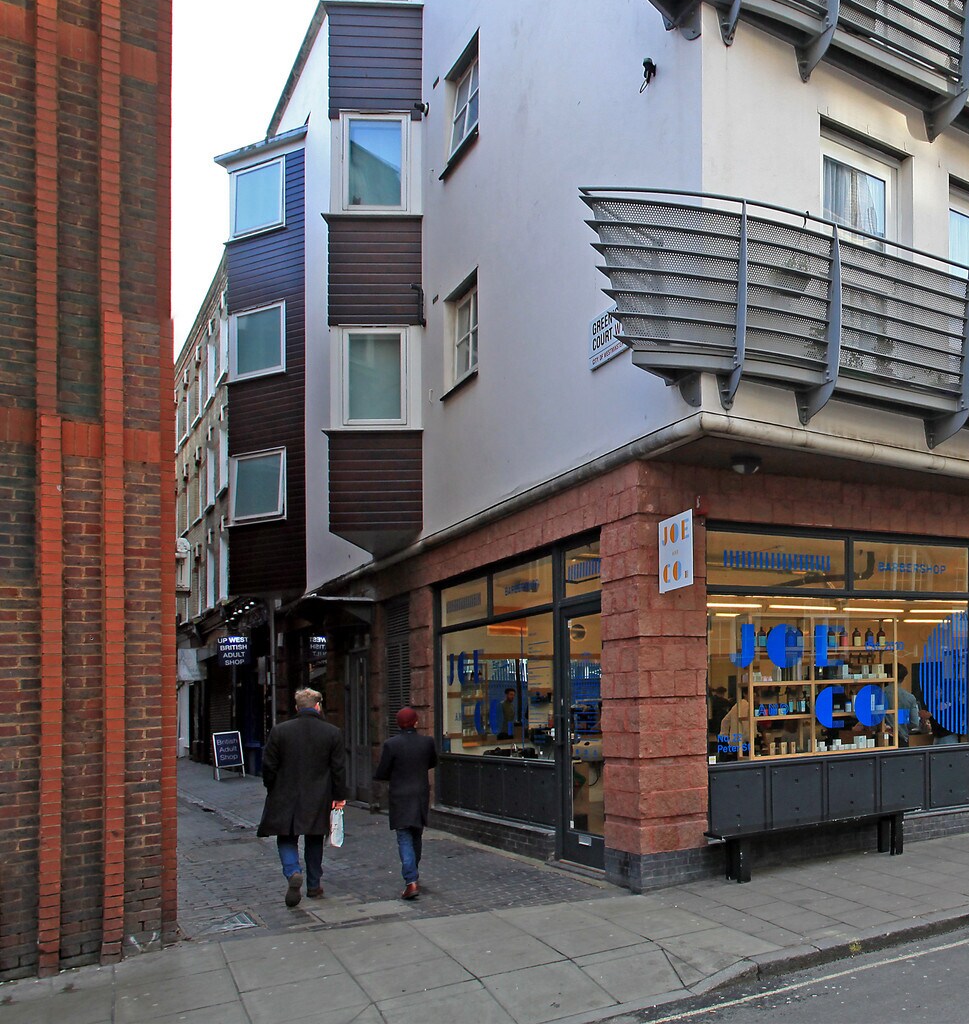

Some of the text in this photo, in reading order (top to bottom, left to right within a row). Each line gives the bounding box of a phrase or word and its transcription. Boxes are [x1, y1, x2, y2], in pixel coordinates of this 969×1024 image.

[592, 326, 613, 351] COURT
[661, 518, 690, 546] JOE
[662, 560, 689, 584] CO.
[877, 561, 947, 575] BARBERSHOP
[729, 623, 845, 669] JOE
[758, 703, 790, 717] AND
[216, 738, 238, 746] British
[717, 742, 751, 753] Peter St
